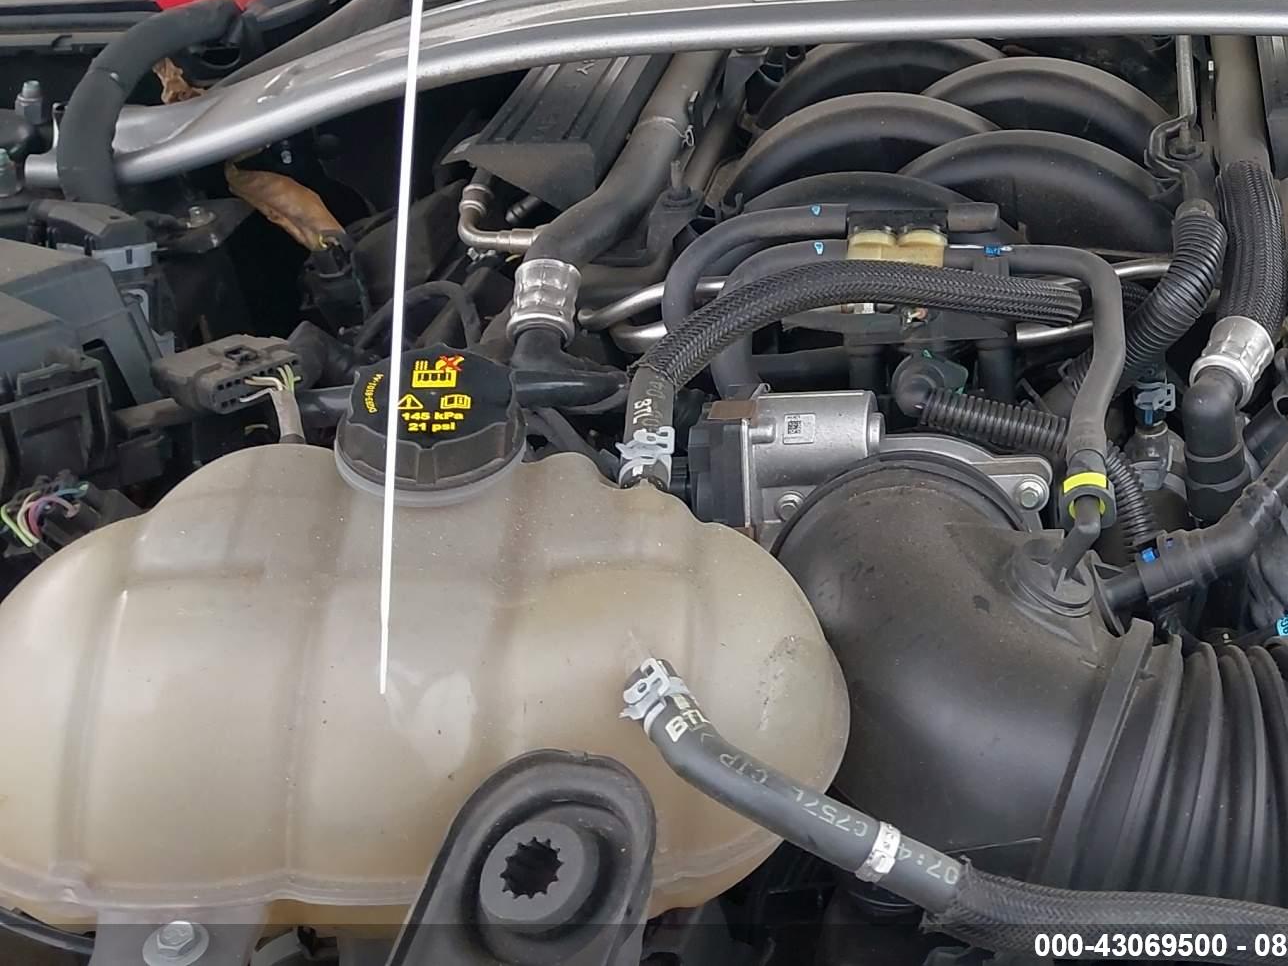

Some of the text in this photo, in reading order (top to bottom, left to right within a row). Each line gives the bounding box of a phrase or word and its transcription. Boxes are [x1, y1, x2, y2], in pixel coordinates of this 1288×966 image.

[401, 411, 464, 421] 145 kPa
[407, 422, 456, 433] 21 psi
[893, 840, 959, 885] 07:4
